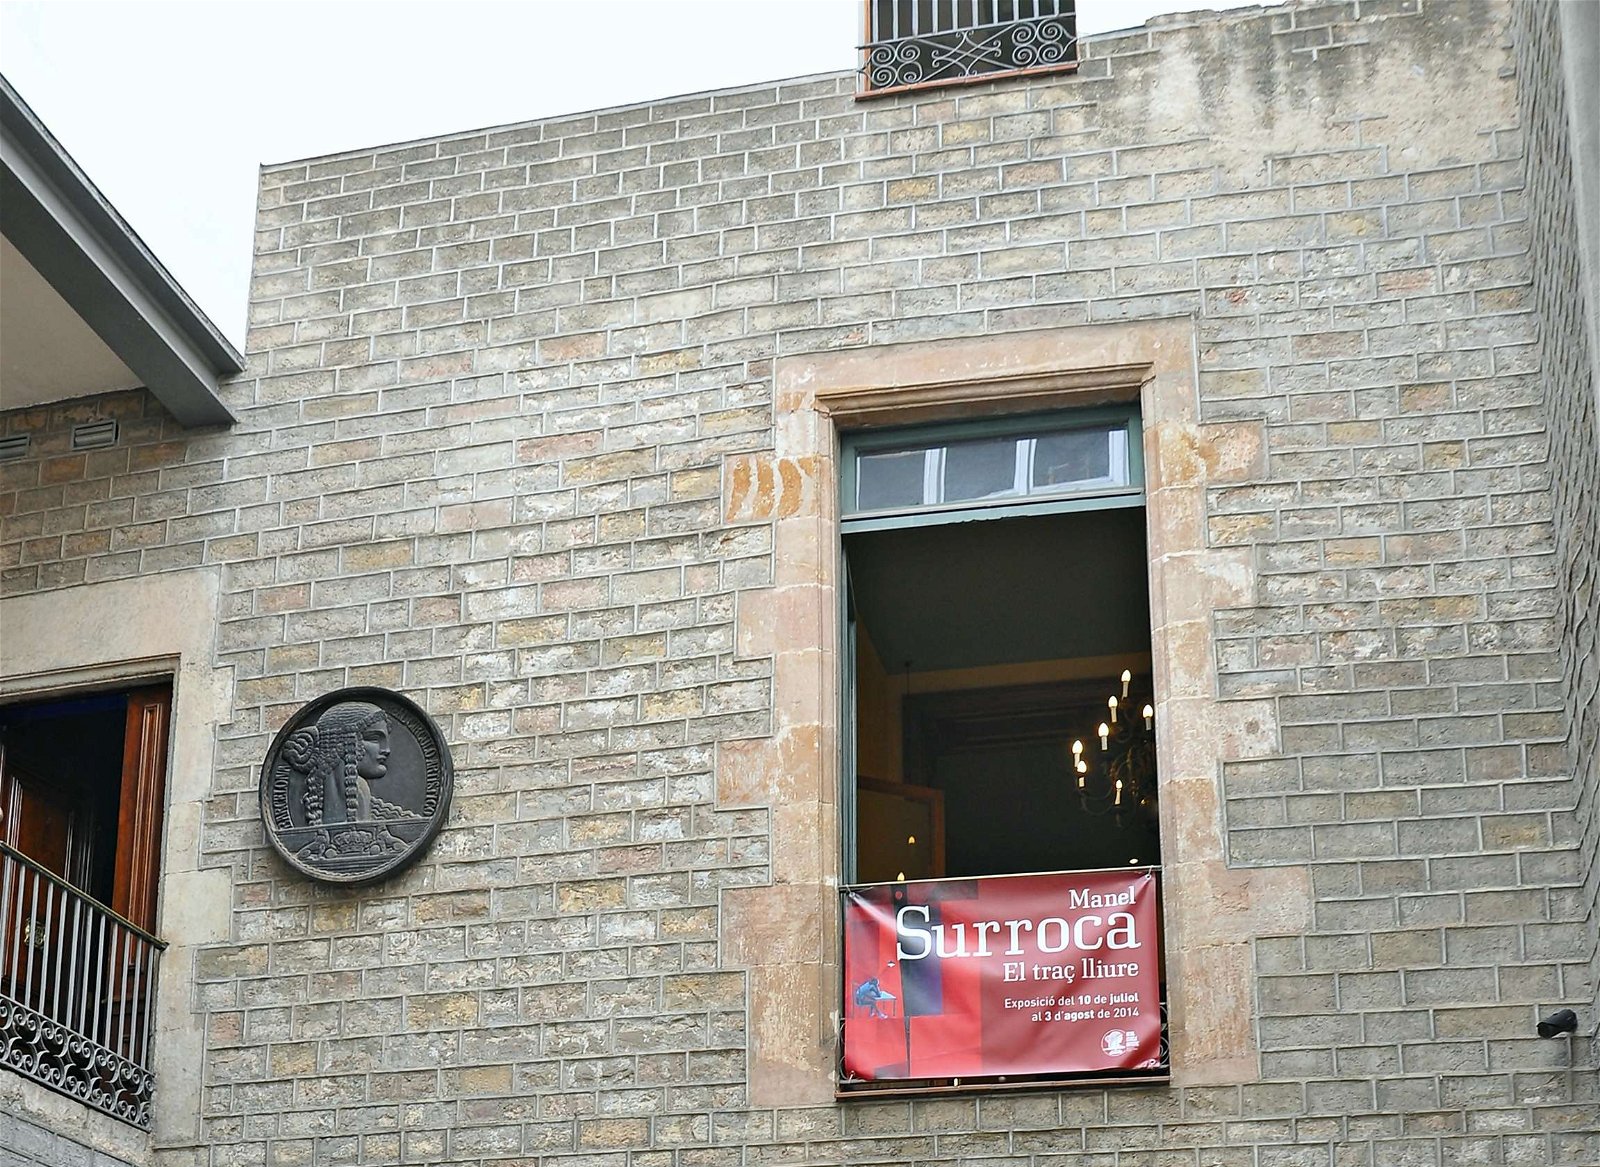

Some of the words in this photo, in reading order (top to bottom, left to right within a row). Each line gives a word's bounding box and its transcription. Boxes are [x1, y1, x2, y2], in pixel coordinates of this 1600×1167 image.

[1069, 886, 1136, 909] Manel
[896, 905, 1142, 961] Surroca
[1003, 962, 1026, 982] El
[1032, 963, 1075, 984] traç
[1081, 958, 1139, 979] lliure
[1004, 996, 1056, 1010] Exposició
[1058, 996, 1075, 1006] del
[1078, 994, 1091, 1005] 10
[1093, 994, 1107, 1004] de
[1109, 992, 1139, 1005] juliol
[1031, 1011, 1042, 1021] al
[1044, 1011, 1052, 1021] 3
[1054, 1009, 1095, 1022] d'agost
[1097, 1009, 1111, 1019] de
[1113, 1007, 1139, 1018] 2014
